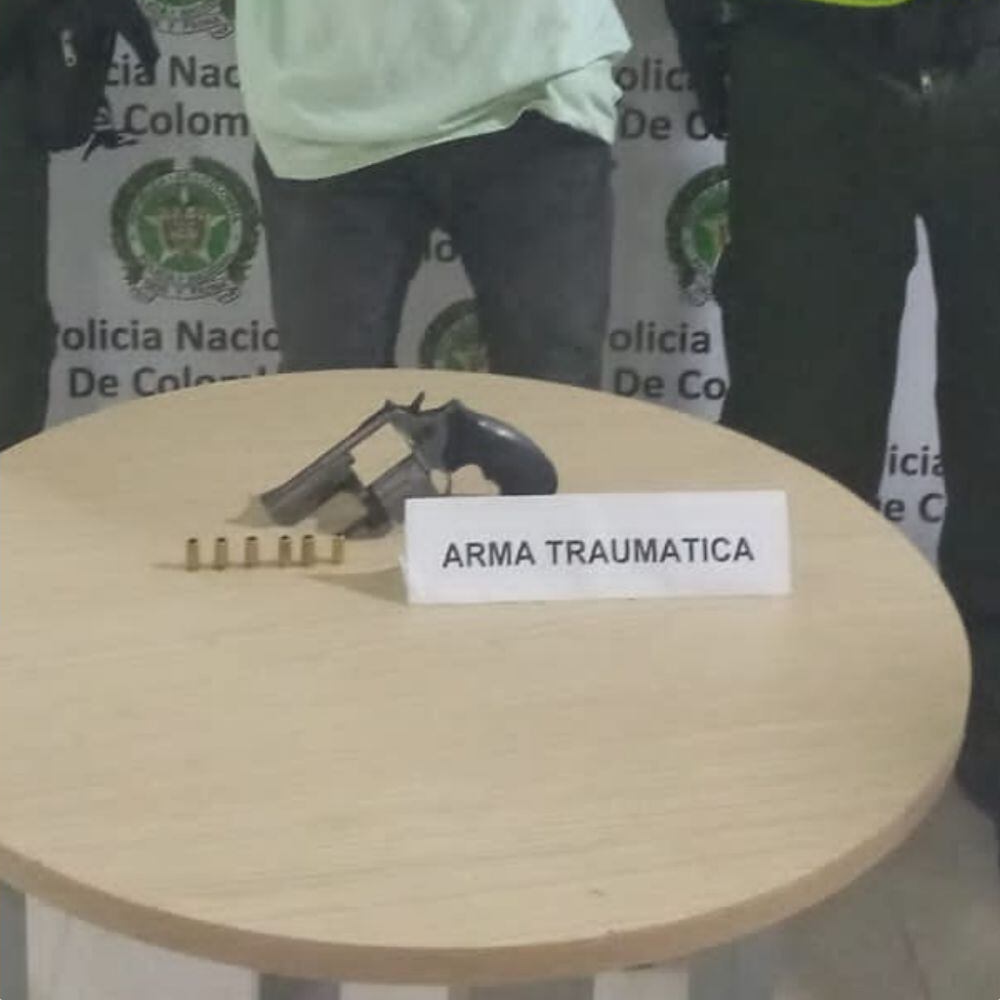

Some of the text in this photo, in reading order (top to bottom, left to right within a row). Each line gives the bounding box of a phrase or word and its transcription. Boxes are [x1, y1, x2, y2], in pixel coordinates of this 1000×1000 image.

[124, 101, 249, 136] Colom
[621, 107, 671, 141] De
[55, 318, 163, 350] olicia
[609, 320, 711, 354] olicia
[69, 366, 119, 398] De
[615, 367, 665, 397] De
[442, 536, 755, 569] ARMA TRAUMATICA
